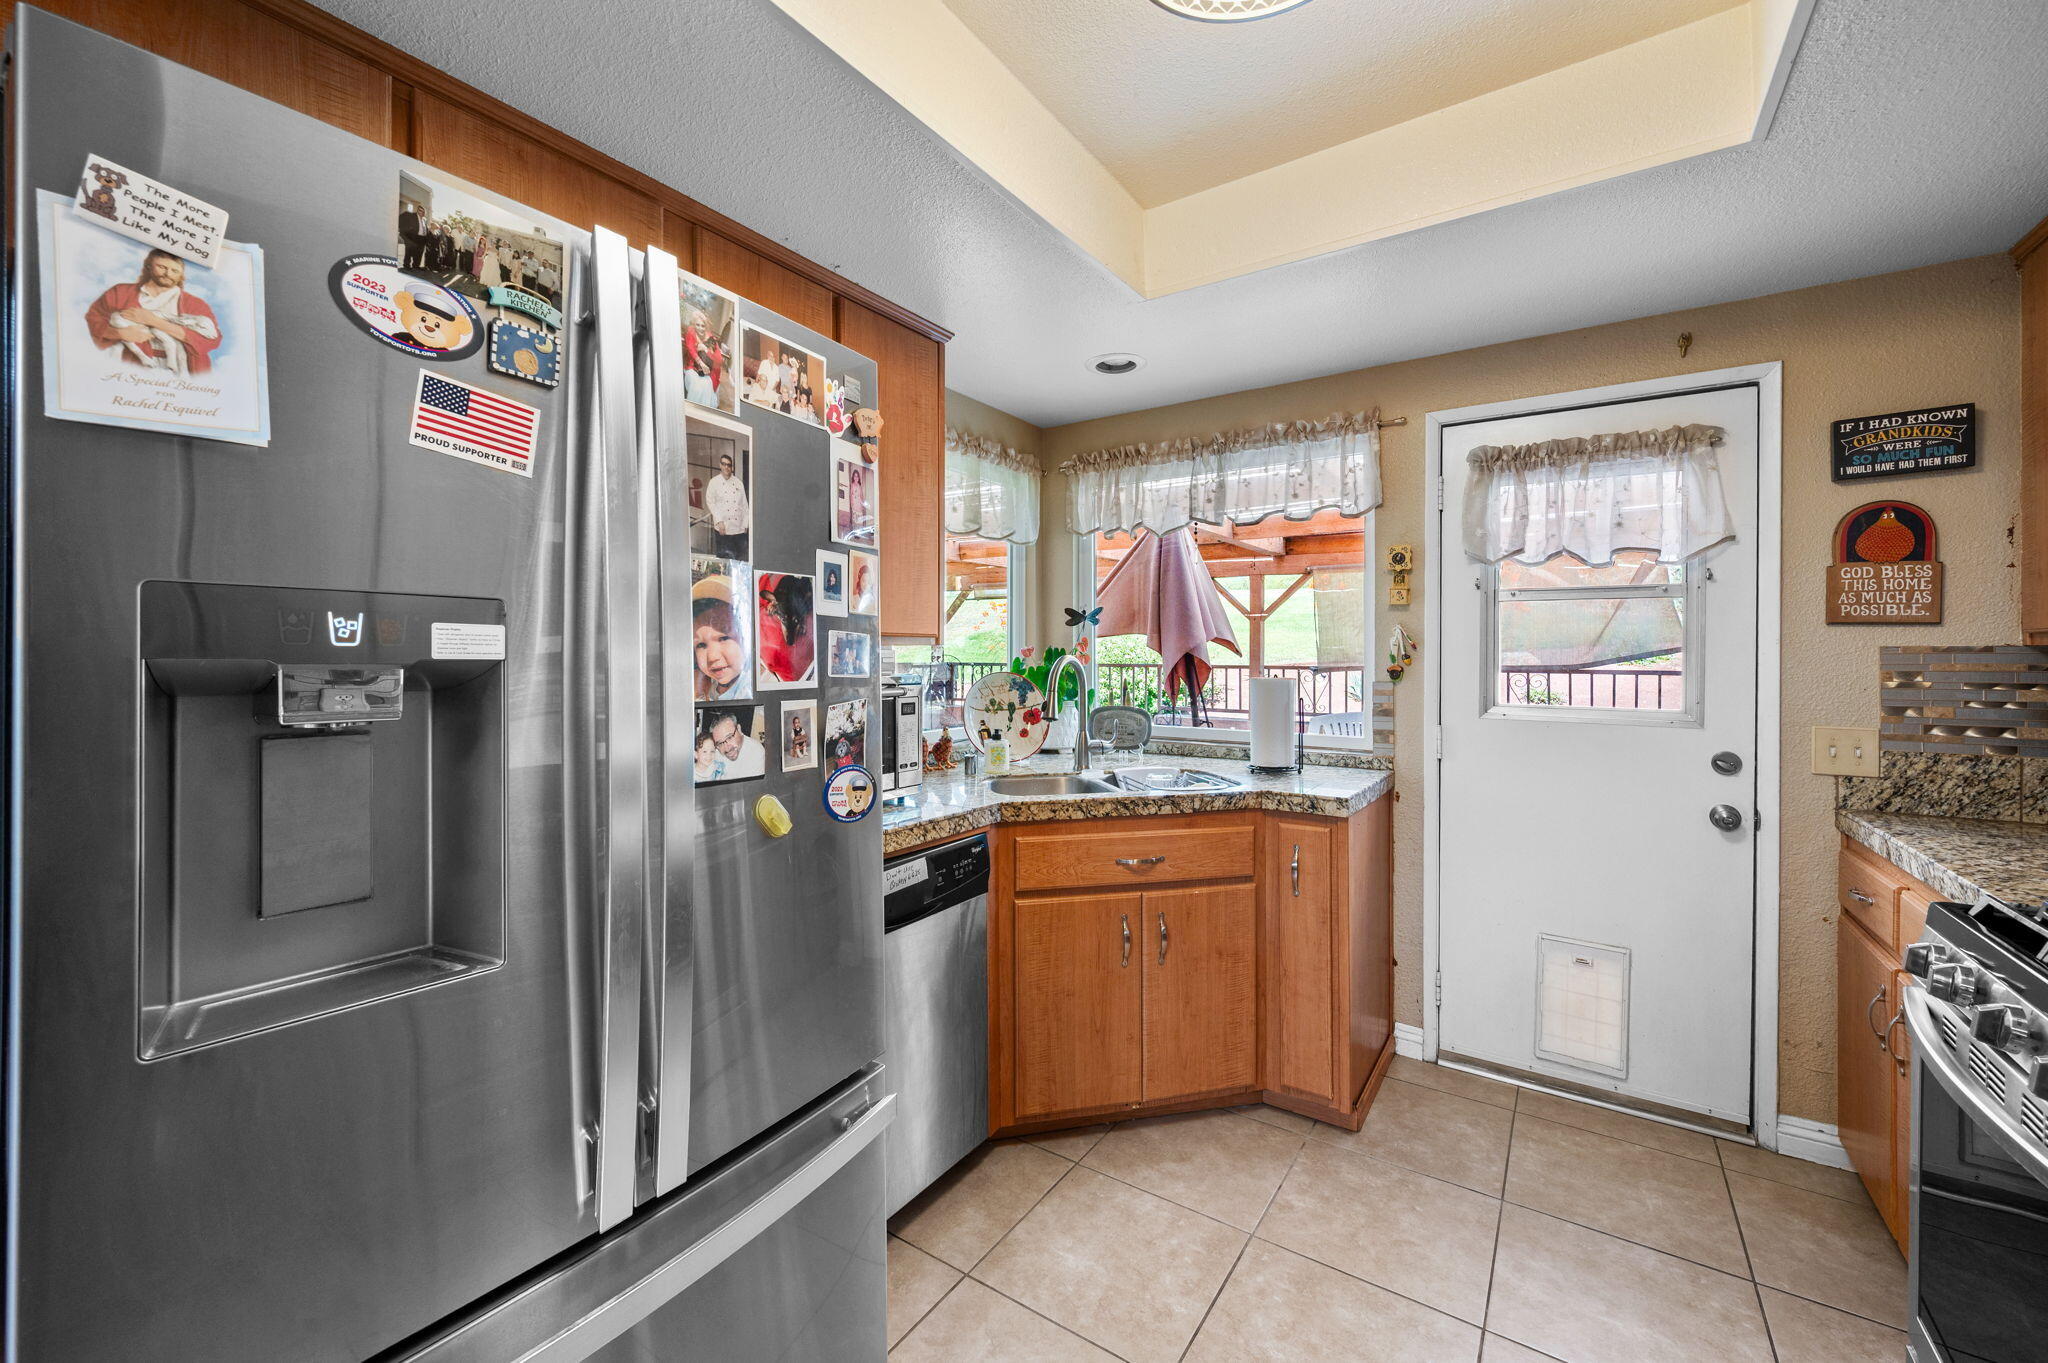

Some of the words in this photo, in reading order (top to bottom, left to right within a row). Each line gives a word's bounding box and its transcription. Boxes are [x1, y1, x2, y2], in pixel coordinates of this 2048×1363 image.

[124, 190, 165, 212] People
[170, 209, 178, 218] I
[145, 184, 169, 200] The
[176, 199, 210, 218] More
[130, 205, 156, 222] The
[162, 220, 197, 239] More
[122, 217, 151, 234] Like
[158, 232, 178, 246] My
[185, 243, 209, 258] Dog
[346, 281, 388, 301] SUPPORTER
[353, 274, 385, 293] 2023
[507, 291, 552, 314] RACHEL'S
[511, 300, 547, 318] KITCHEN
[370, 328, 437, 357] TOYSFORTOTS.ORG
[100, 372, 121, 381] A
[125, 374, 170, 387] Special
[174, 380, 221, 397] Blessing
[112, 396, 160, 410] Rachel
[163, 401, 221, 417] Esquivel
[1840, 422, 1854, 432] IF
[1859, 422, 1864, 430] I
[1869, 418, 1902, 429] HAD
[1907, 408, 1968, 425] KNOWN
[1852, 425, 1953, 448] GRANDKIDS
[1882, 440, 1922, 451] WERE
[414, 432, 450, 448] PROUD
[452, 443, 507, 465] SUPPORTER
[1852, 454, 1871, 465] SO
[1877, 450, 1920, 462] MUCH
[1926, 445, 1955, 457] FUN
[1846, 465, 1872, 474] WOULD
[1875, 462, 1895, 472] HAVE
[1899, 460, 1915, 469] HAD
[1918, 457, 1941, 467] THEM
[1944, 454, 1968, 464] FIRST
[1840, 567, 1874, 578] GOD
[1881, 564, 1932, 578] BLESS
[1841, 579, 1877, 591] THIS
[1883, 578, 1932, 590] HOME
[1838, 592, 1856, 604] AS
[1862, 592, 1907, 603] MUCH
[1912, 591, 1932, 603] AS
[1841, 604, 1930, 616] POSSIBLE.
